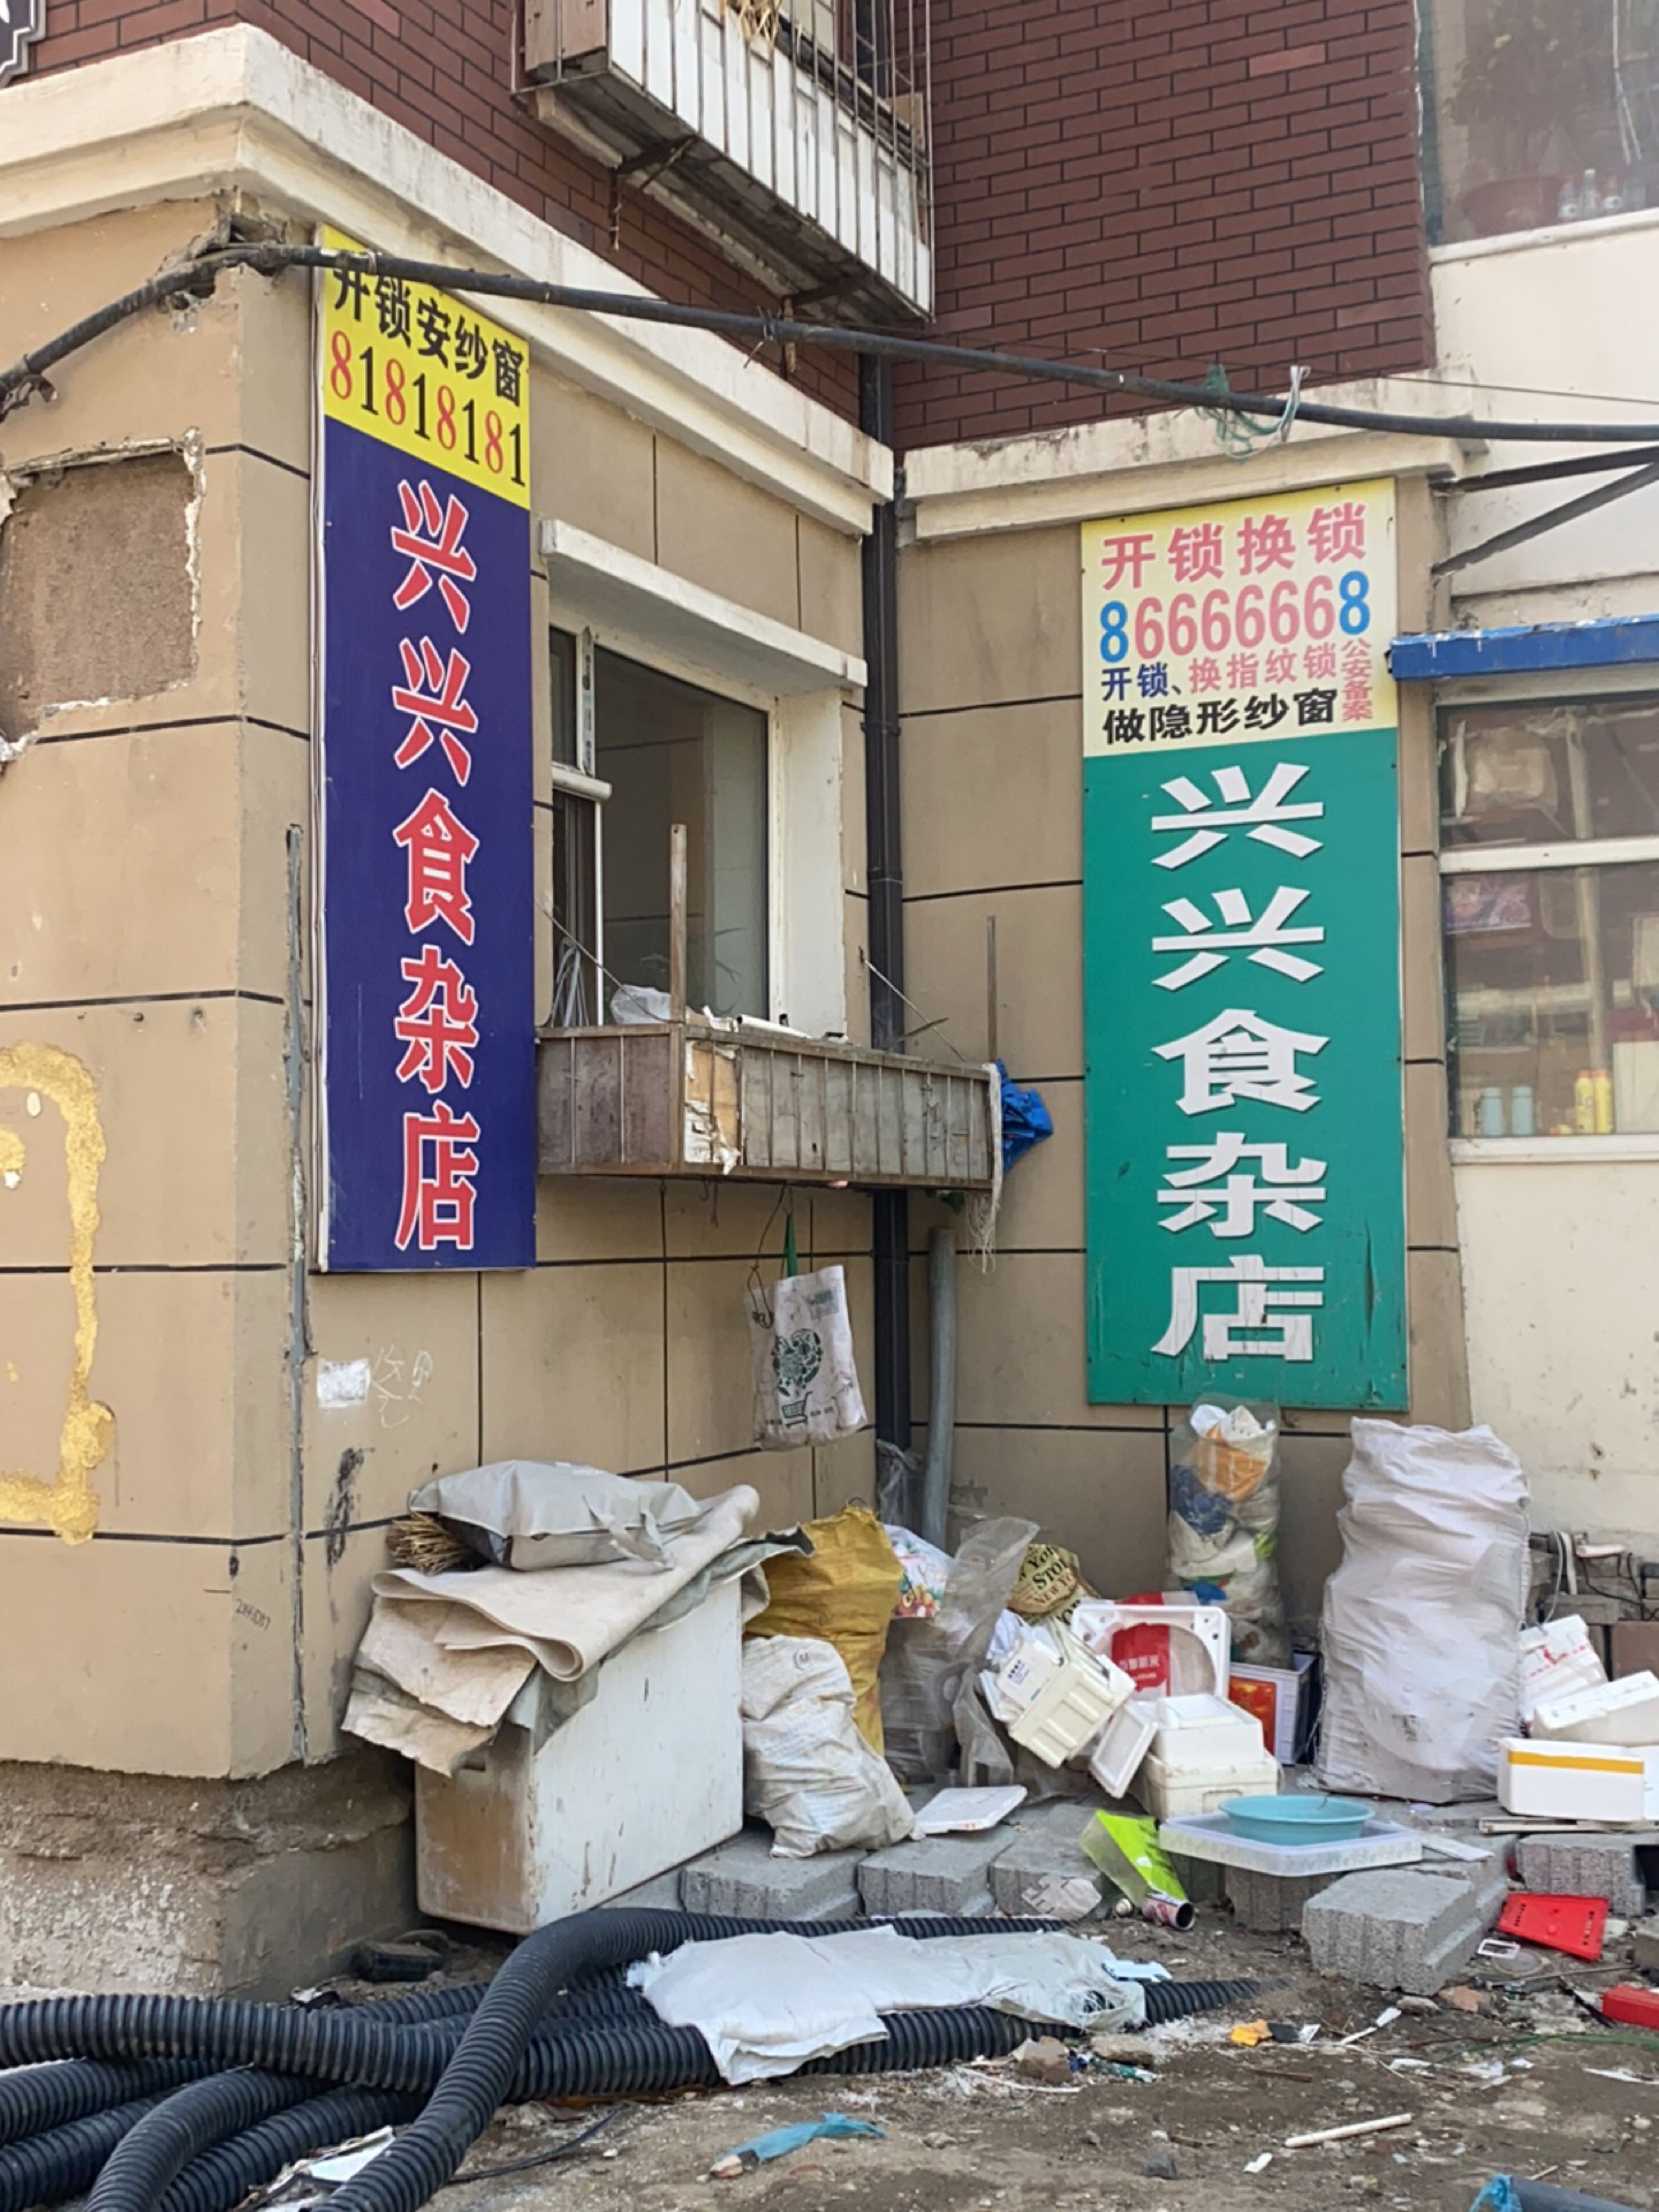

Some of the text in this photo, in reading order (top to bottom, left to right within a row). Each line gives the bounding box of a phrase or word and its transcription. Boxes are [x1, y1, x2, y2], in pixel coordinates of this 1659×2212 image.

[333, 267, 524, 406] 开锁安纱窗
[330, 330, 525, 487] 81818181
[1101, 502, 1366, 591] 开锁换锁
[1100, 570, 1370, 663] 86666668
[1102, 687, 1338, 745] 做隐形纱窗
[1340, 637, 1373, 722] 公安备案
[390, 479, 481, 1251] 兴兴食杂店
[1151, 761, 1331, 1362] 兴兴食杂店
